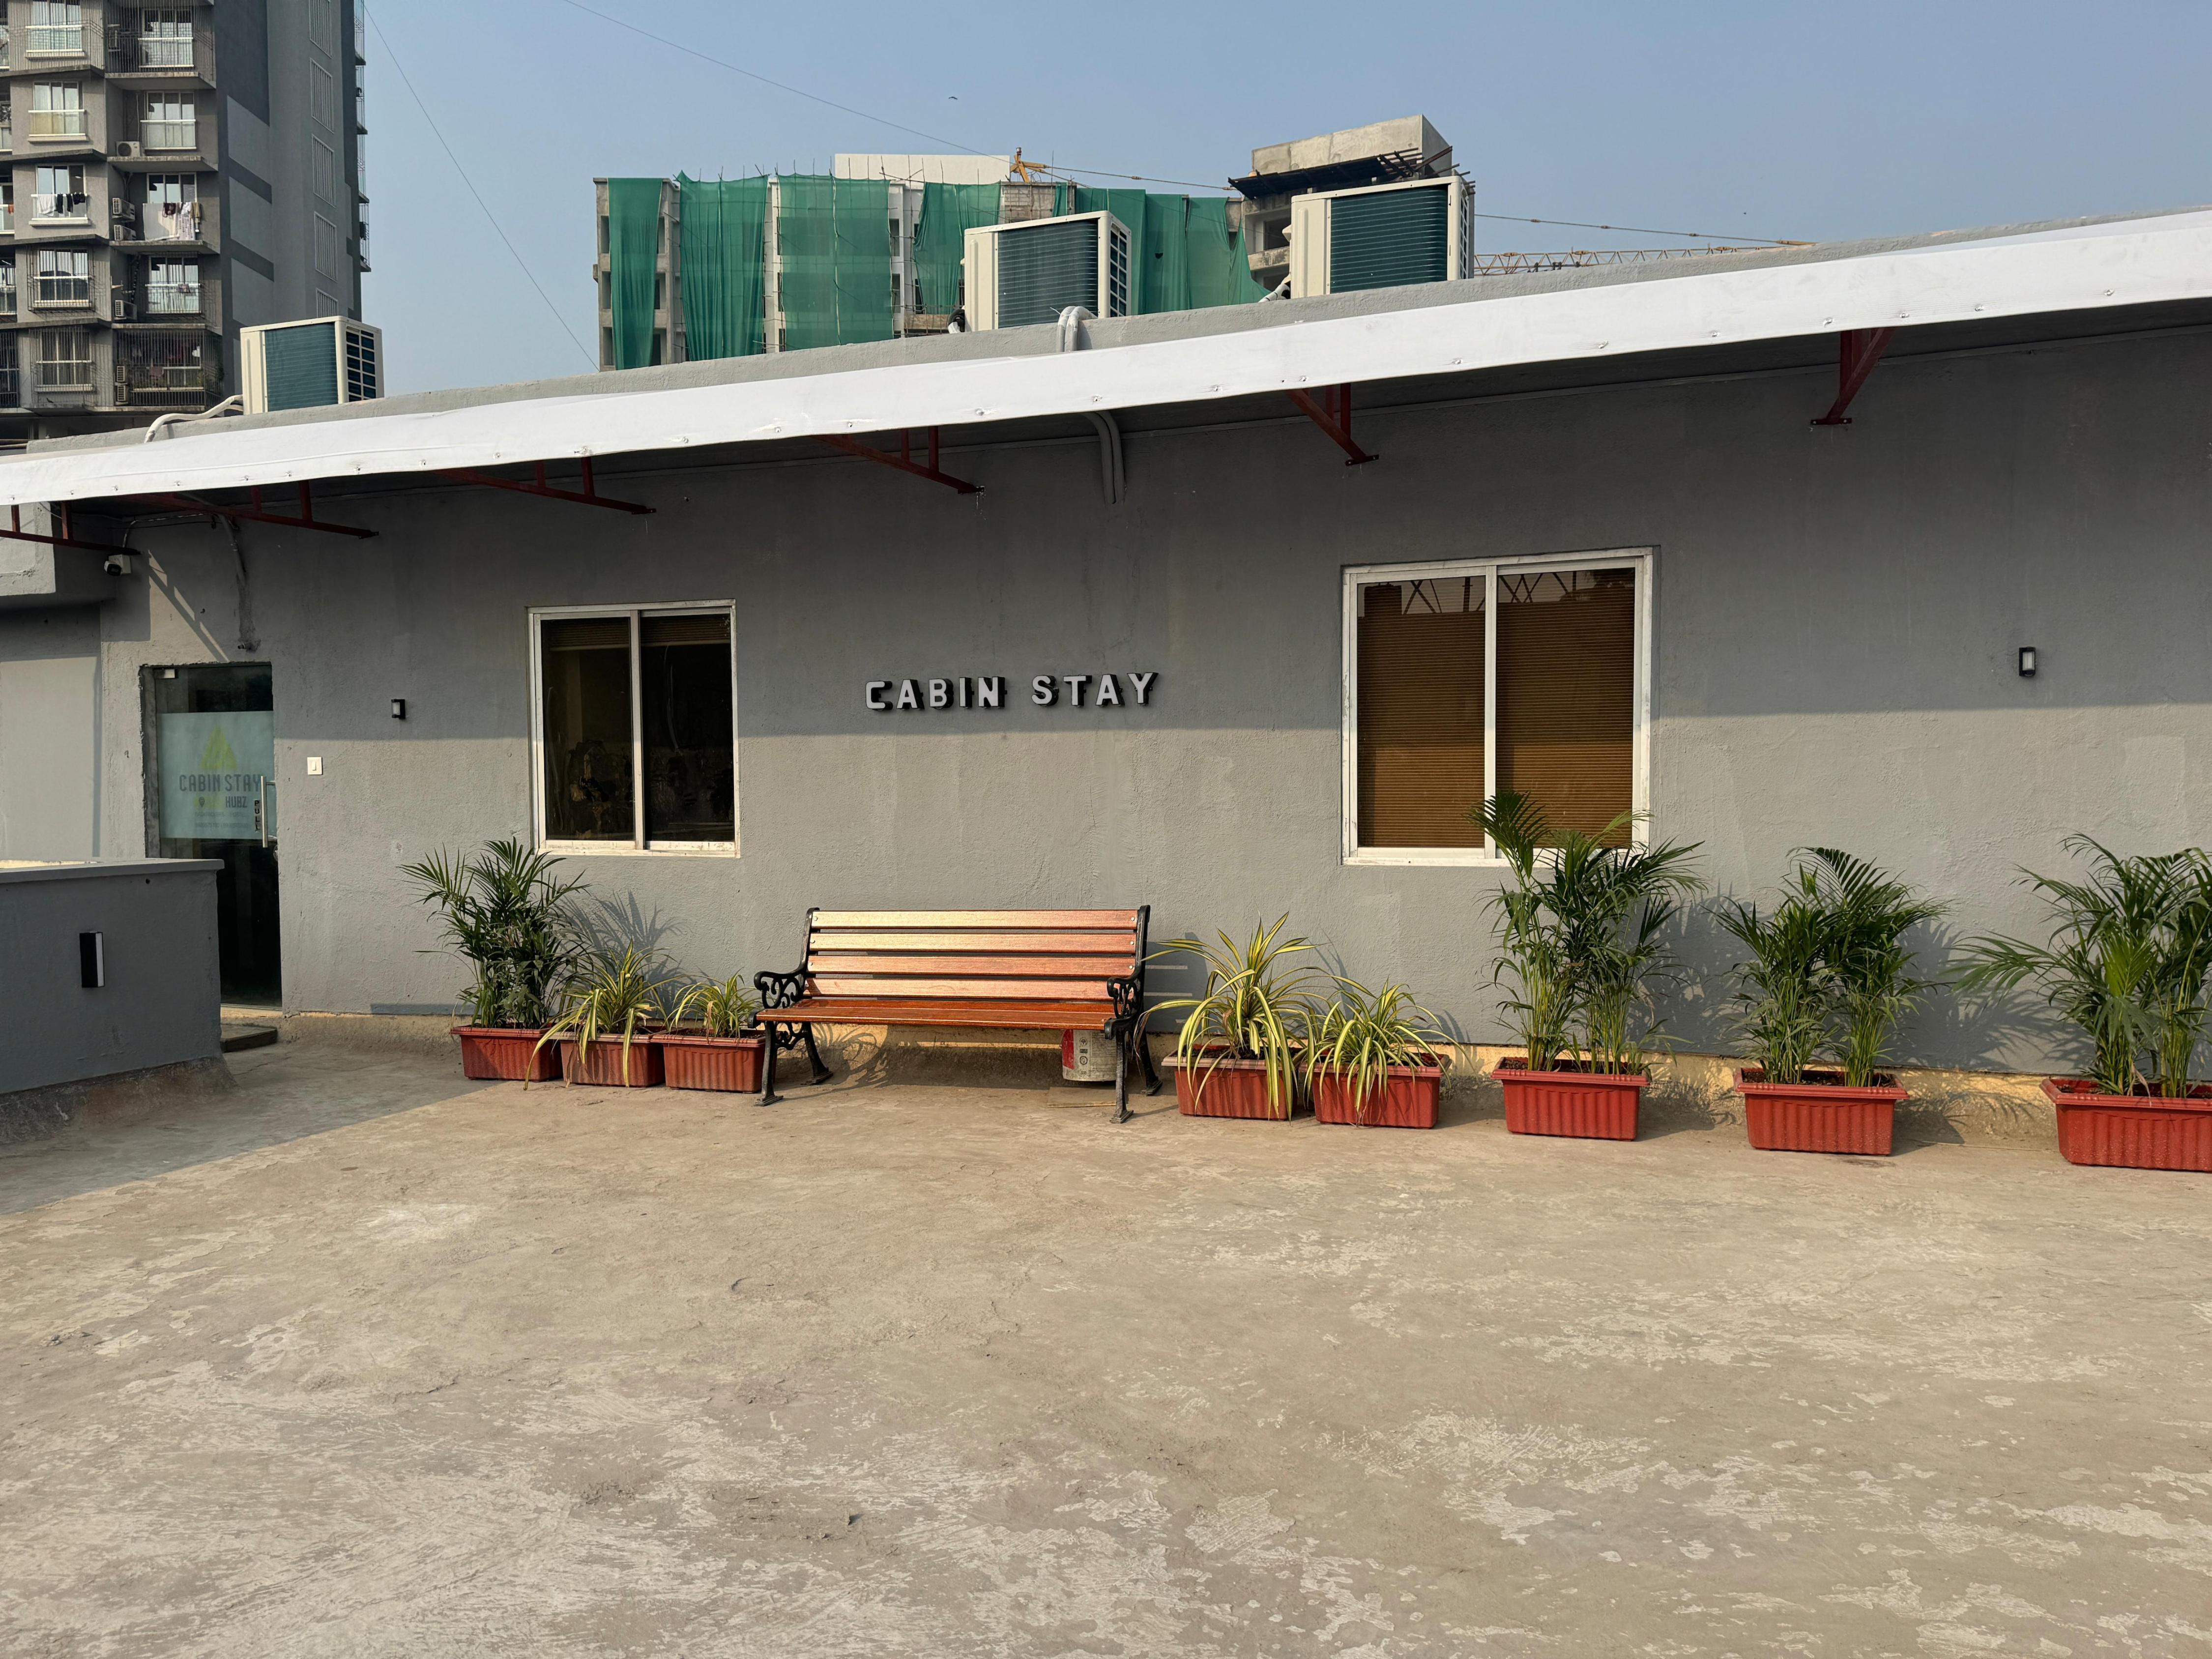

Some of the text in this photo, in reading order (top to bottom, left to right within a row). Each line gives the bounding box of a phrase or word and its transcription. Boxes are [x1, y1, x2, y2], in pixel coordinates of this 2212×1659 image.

[866, 672, 1159, 710] CABIN STAY
[179, 774, 261, 791] CABIN STAY
[225, 796, 248, 808] HUBZ
